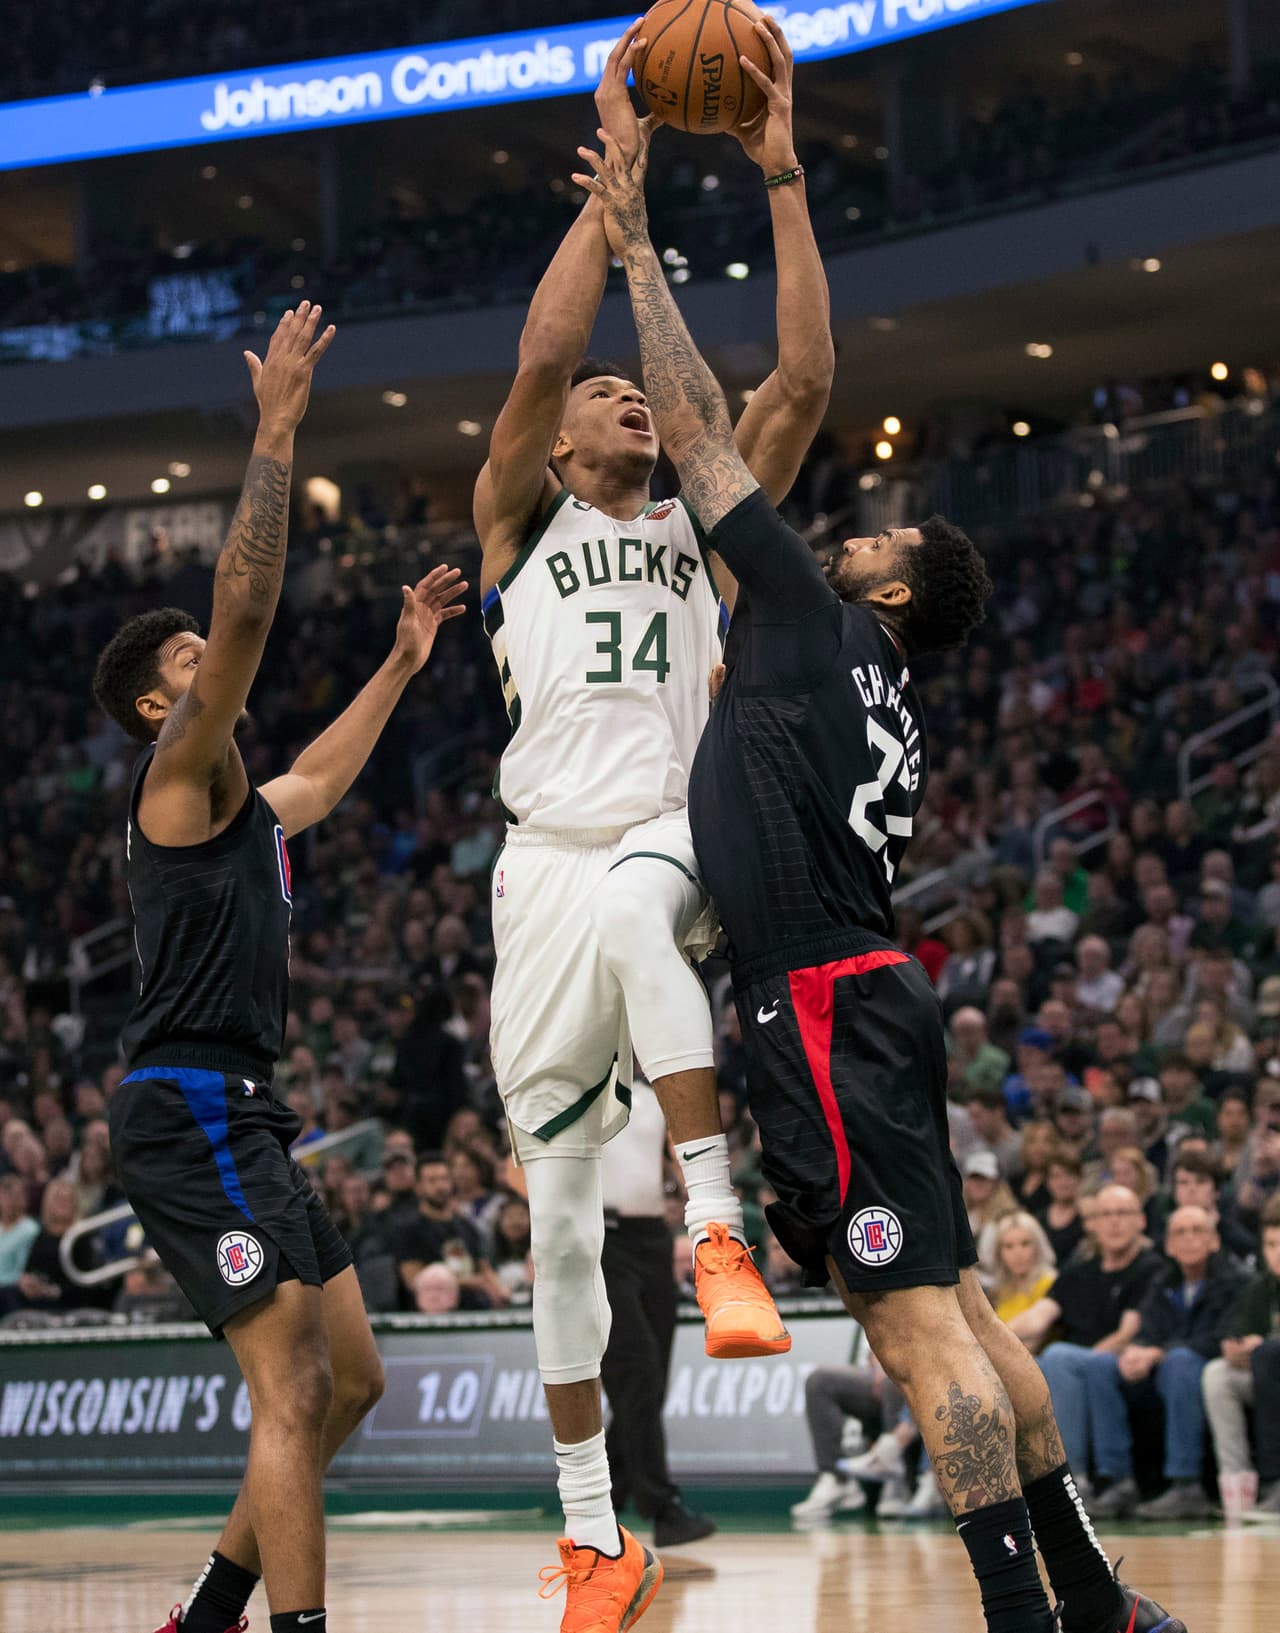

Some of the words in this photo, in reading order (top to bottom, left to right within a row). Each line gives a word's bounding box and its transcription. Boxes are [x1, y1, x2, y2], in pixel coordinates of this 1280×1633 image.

[201, 76, 383, 131] Johnson
[391, 38, 576, 105] Controls
[546, 538, 699, 601] BUCKS
[585, 611, 670, 684] 34
[0, 1374, 226, 1437] WISCONSIN'S
[417, 1370, 480, 1423] 1.0
[664, 1363, 818, 1417] ACKPOT
